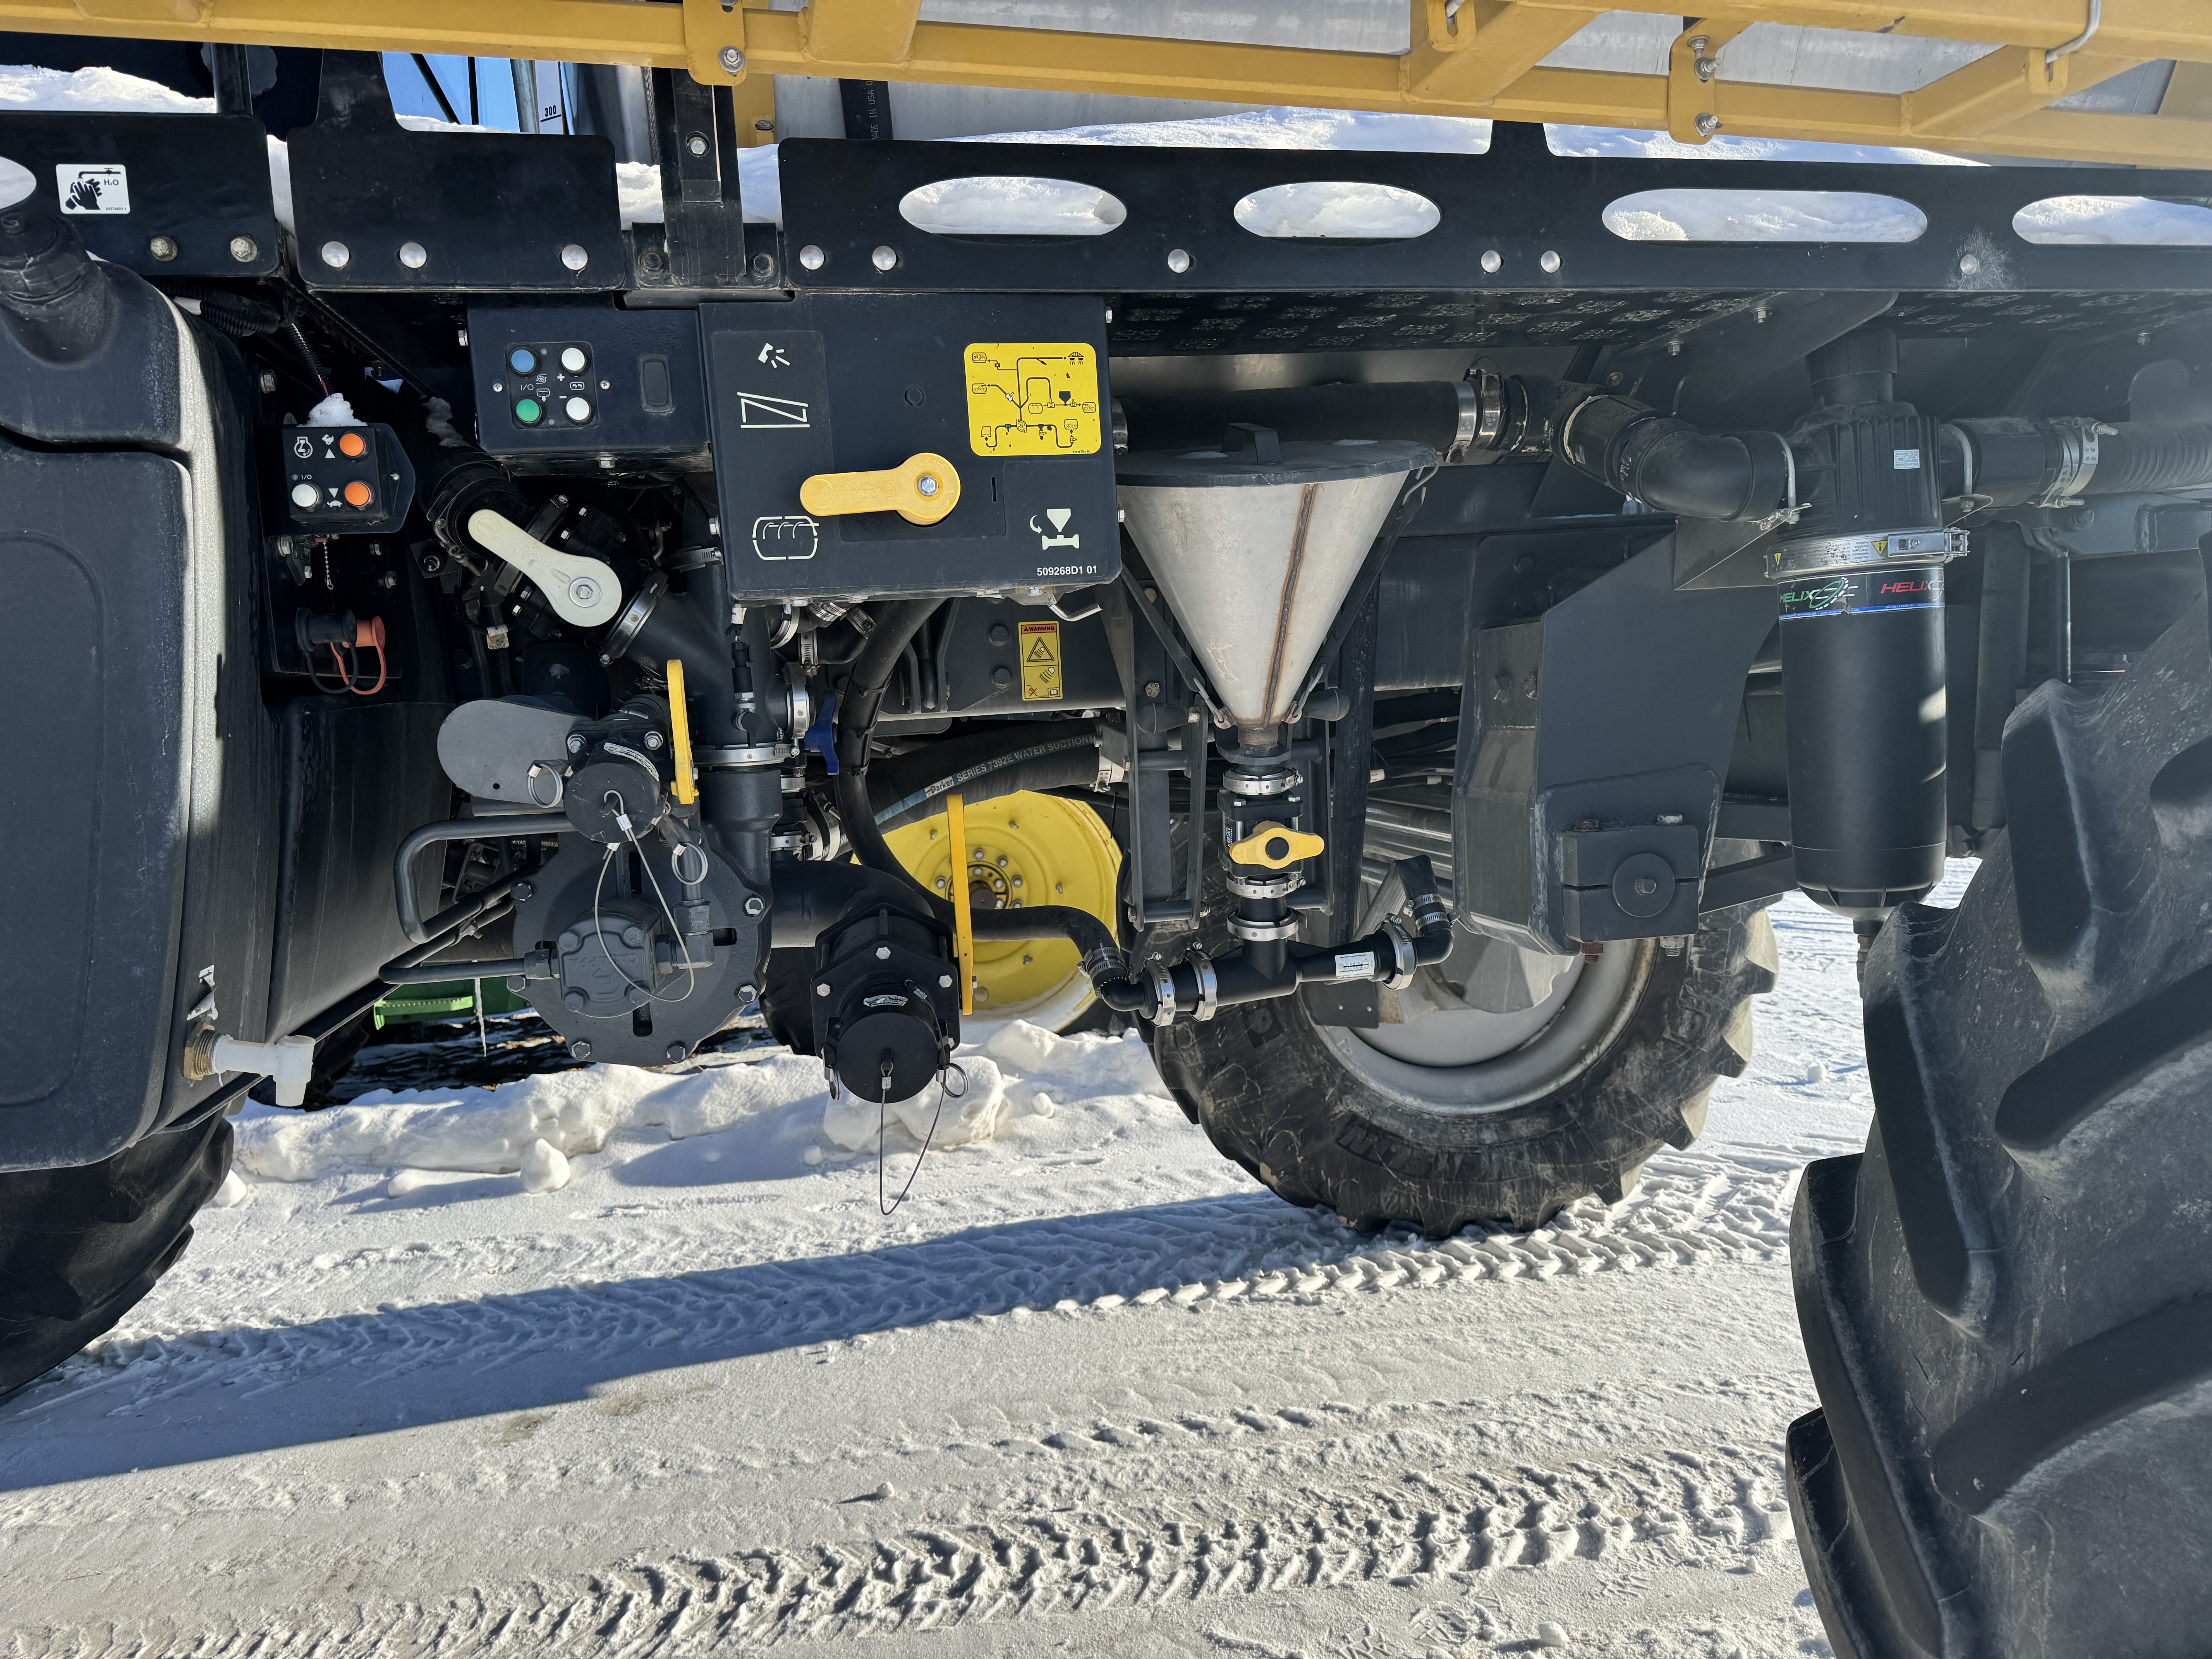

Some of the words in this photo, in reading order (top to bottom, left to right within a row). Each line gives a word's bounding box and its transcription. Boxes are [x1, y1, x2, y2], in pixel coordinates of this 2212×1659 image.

[867, 89, 876, 105] USA
[545, 105, 556, 117] 300
[869, 109, 877, 118] IN
[1037, 566, 1083, 576] 509268D1
[1086, 565, 1097, 574] 01
[1881, 581, 1934, 594] HELIX
[927, 778, 954, 794] Parker
[957, 764, 987, 782] SERIES
[988, 754, 1013, 769] 7392E
[1014, 745, 1046, 760] WATER
